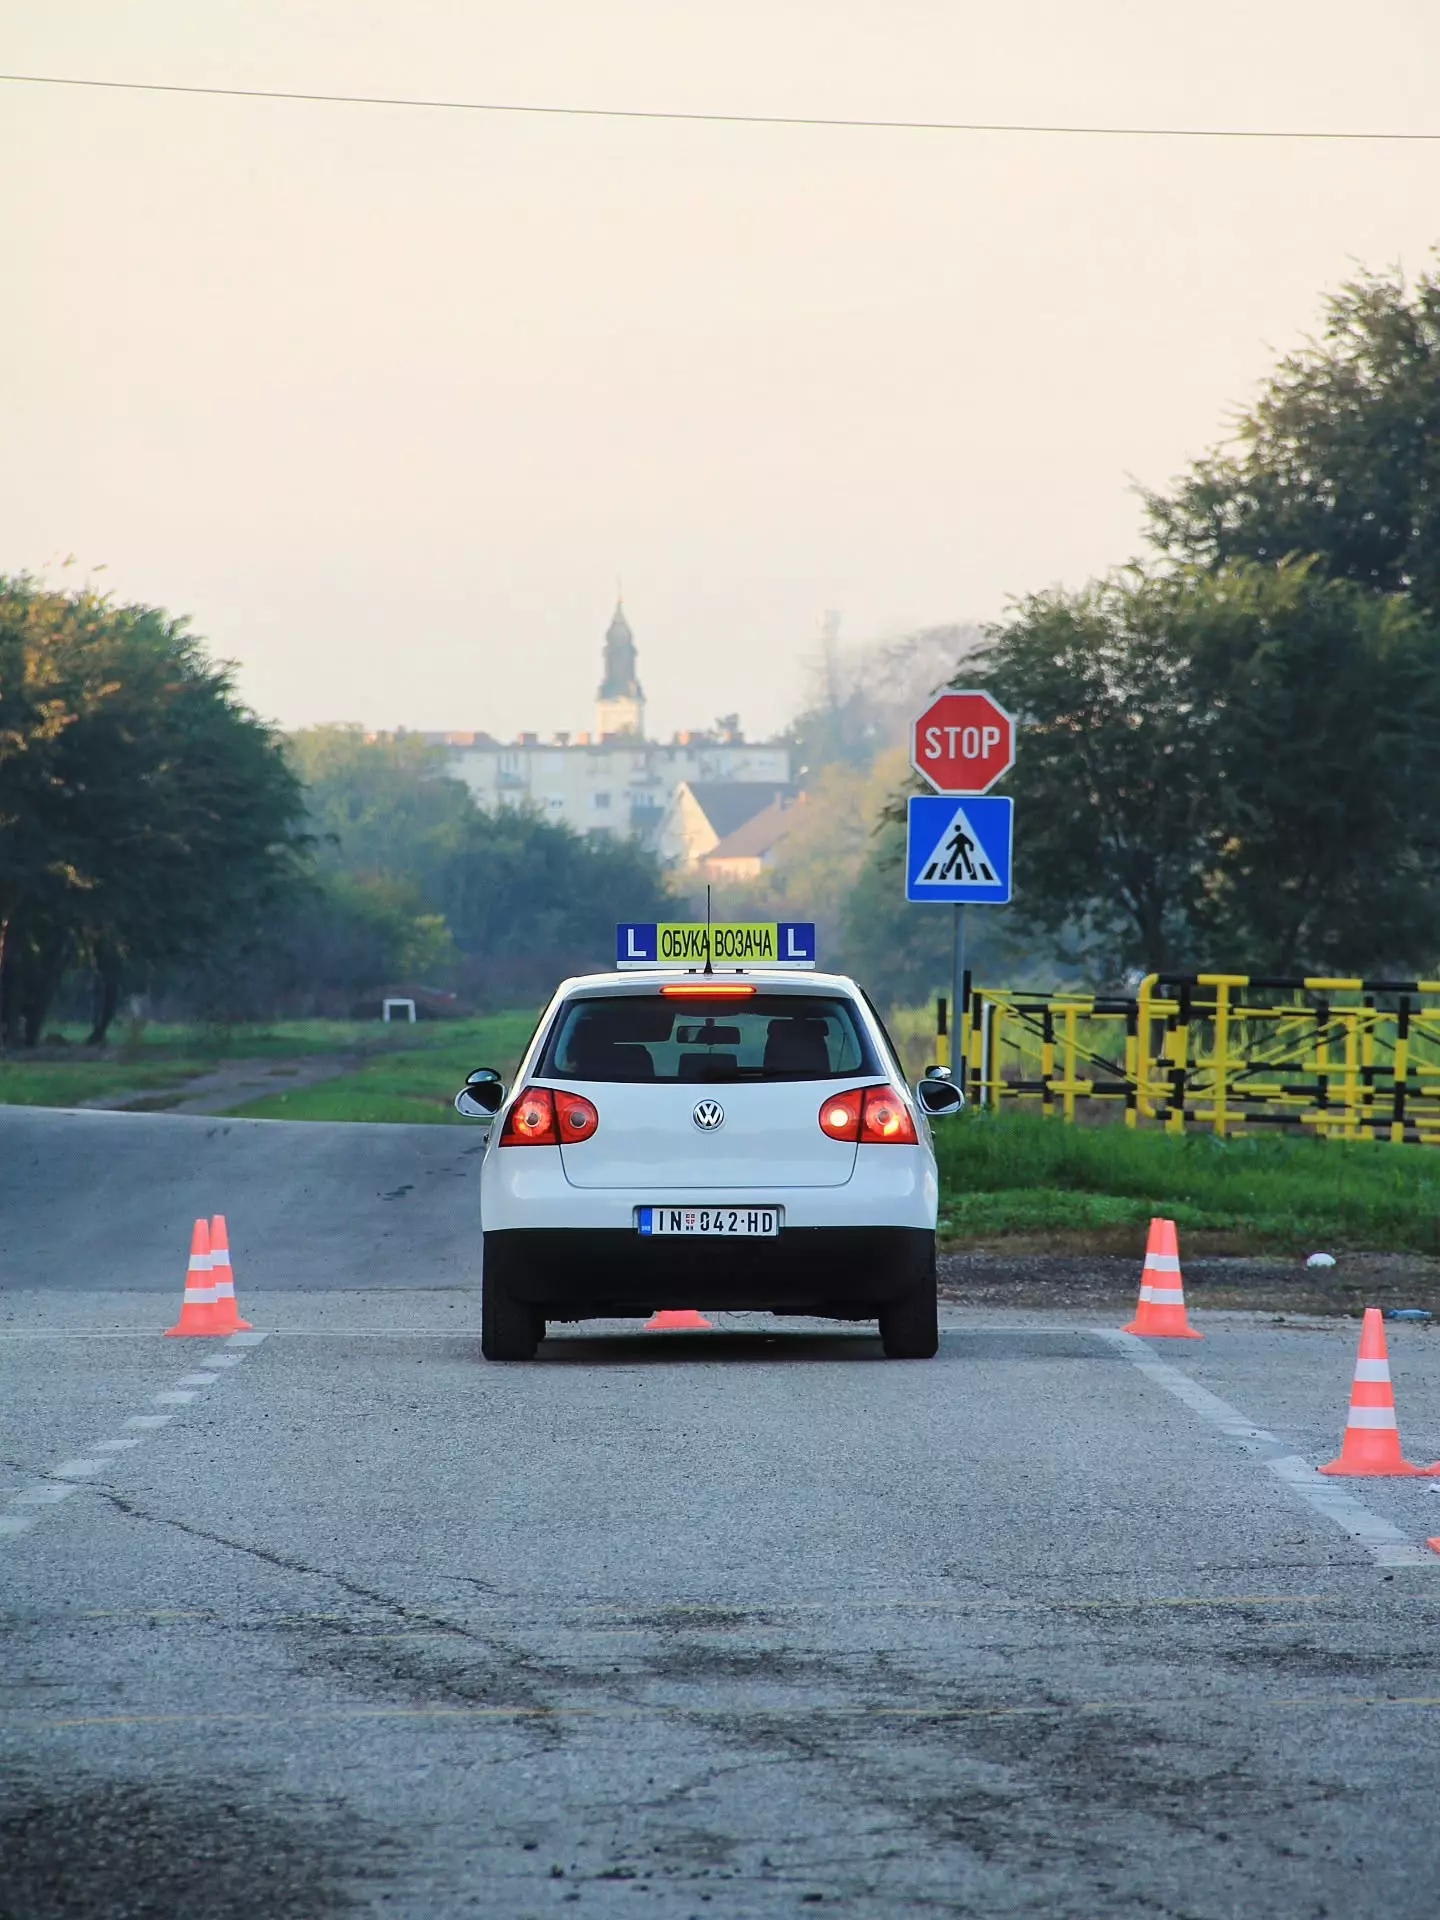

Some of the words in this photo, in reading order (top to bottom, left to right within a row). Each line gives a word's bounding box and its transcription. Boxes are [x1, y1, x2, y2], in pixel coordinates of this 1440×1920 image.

[925, 726, 1000, 759] STOP
[627, 929, 647, 957] L
[661, 929, 710, 957] ОБУКА
[714, 929, 772, 957] ВОЗАЧА
[787, 928, 807, 957] L
[659, 1211, 682, 1231] IN
